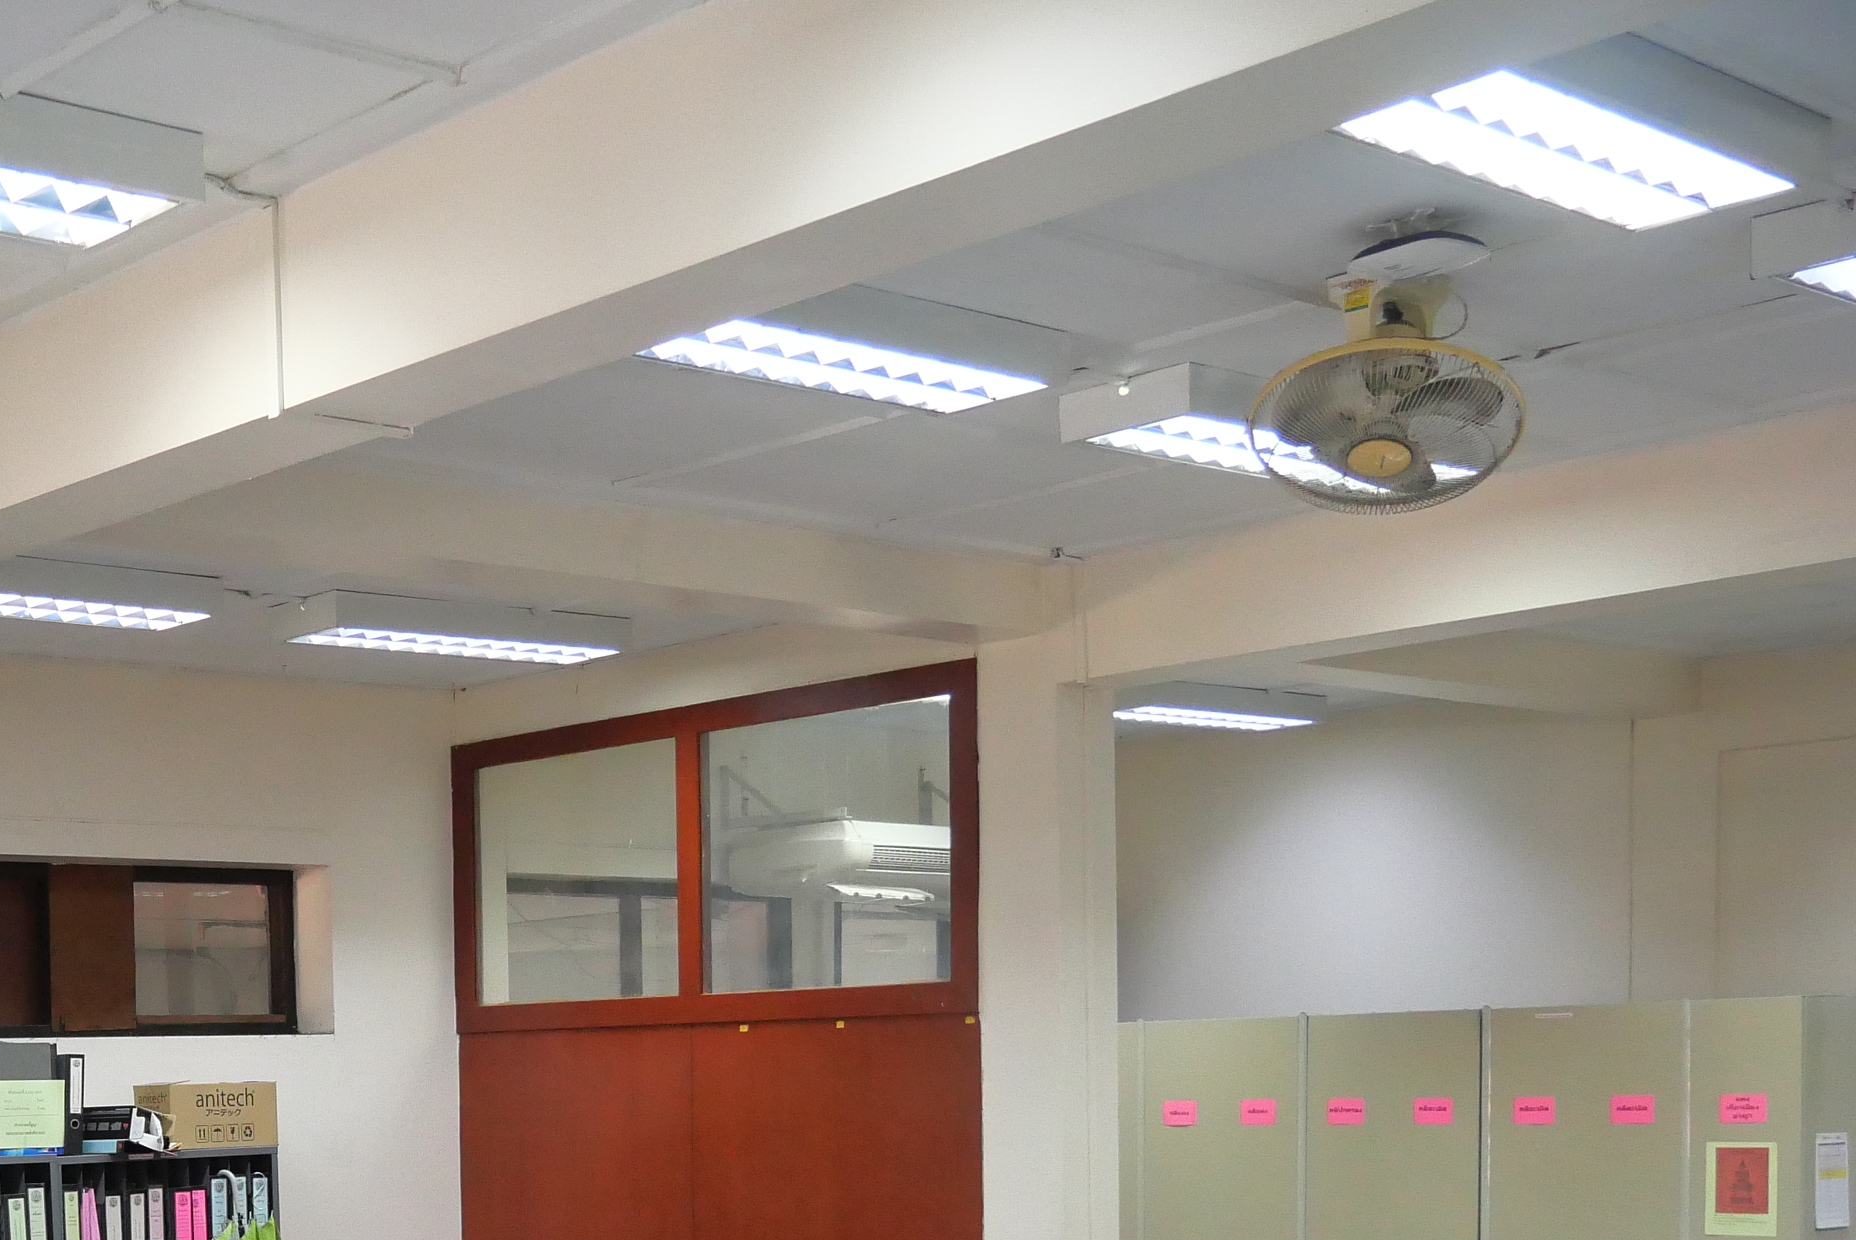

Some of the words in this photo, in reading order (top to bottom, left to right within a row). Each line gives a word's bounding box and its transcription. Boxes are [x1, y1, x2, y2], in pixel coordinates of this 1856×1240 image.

[195, 1087, 255, 1108] anitech
[205, 1108, 241, 1117] アニテック
